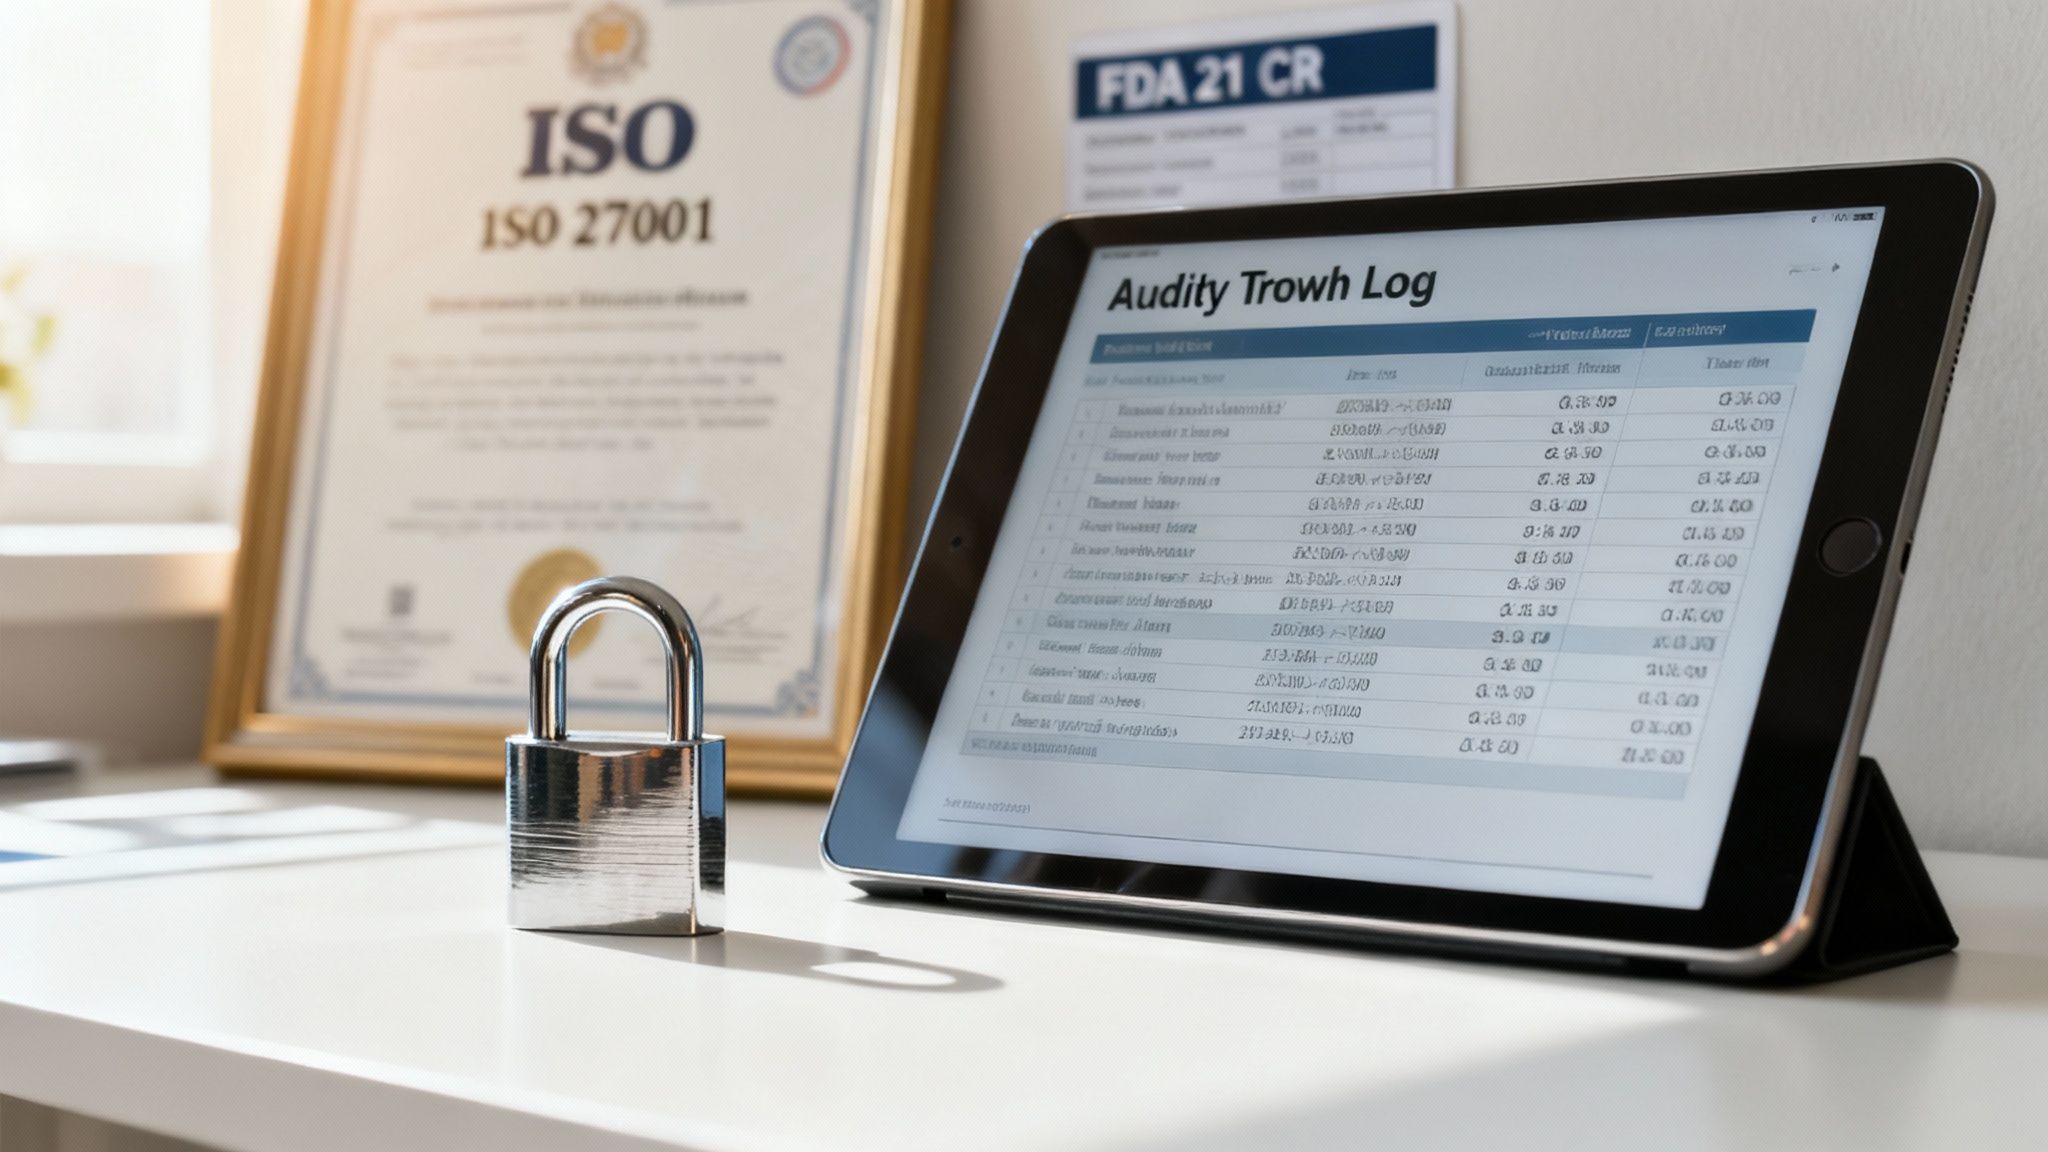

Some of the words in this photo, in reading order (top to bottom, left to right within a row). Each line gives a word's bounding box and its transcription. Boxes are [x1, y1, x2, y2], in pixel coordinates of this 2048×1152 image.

[1096, 60, 1188, 112] FDA
[1194, 53, 1243, 103] 21
[1258, 45, 1325, 97] CR
[521, 98, 697, 179] ISO
[481, 204, 561, 251] ISO
[573, 197, 714, 247] 27001
[1107, 272, 1231, 317] Audity
[1240, 264, 1351, 305] Trowh
[1361, 265, 1438, 308] Log
